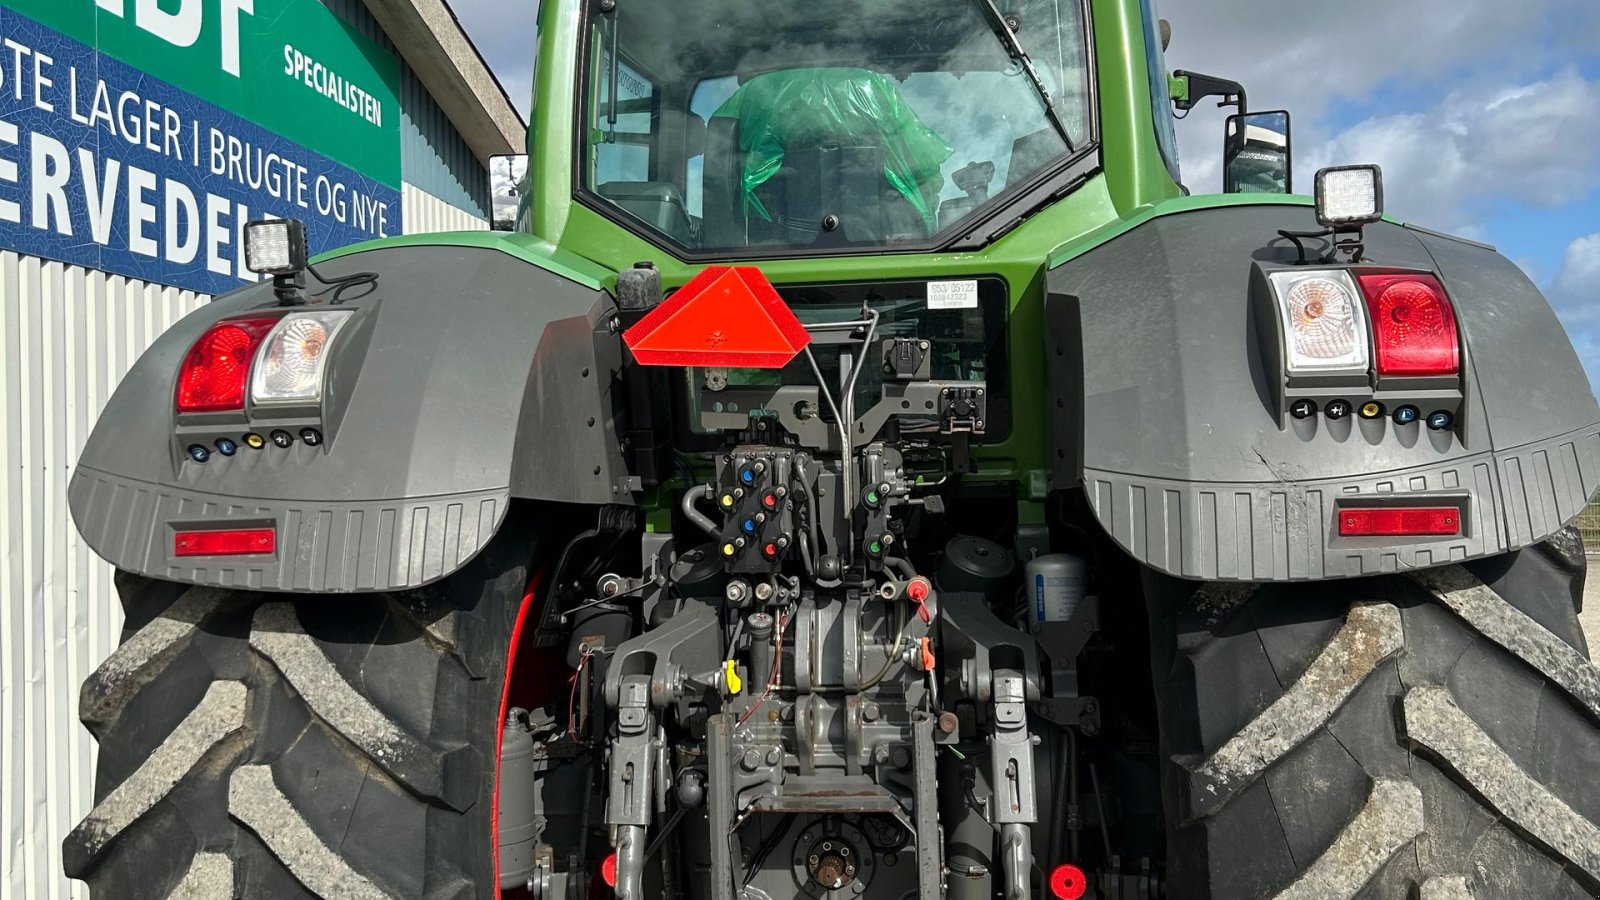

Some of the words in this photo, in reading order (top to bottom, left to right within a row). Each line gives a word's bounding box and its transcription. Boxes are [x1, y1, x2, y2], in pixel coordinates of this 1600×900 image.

[0, 36, 54, 113] TE
[70, 65, 182, 161] LAGER
[193, 119, 199, 168] I
[210, 127, 308, 209] BRUGTE
[315, 174, 346, 223] OG
[352, 189, 388, 238] NYE
[283, 44, 382, 128] SPECIALISTEN
[0, 119, 286, 284] ERVEDEL
